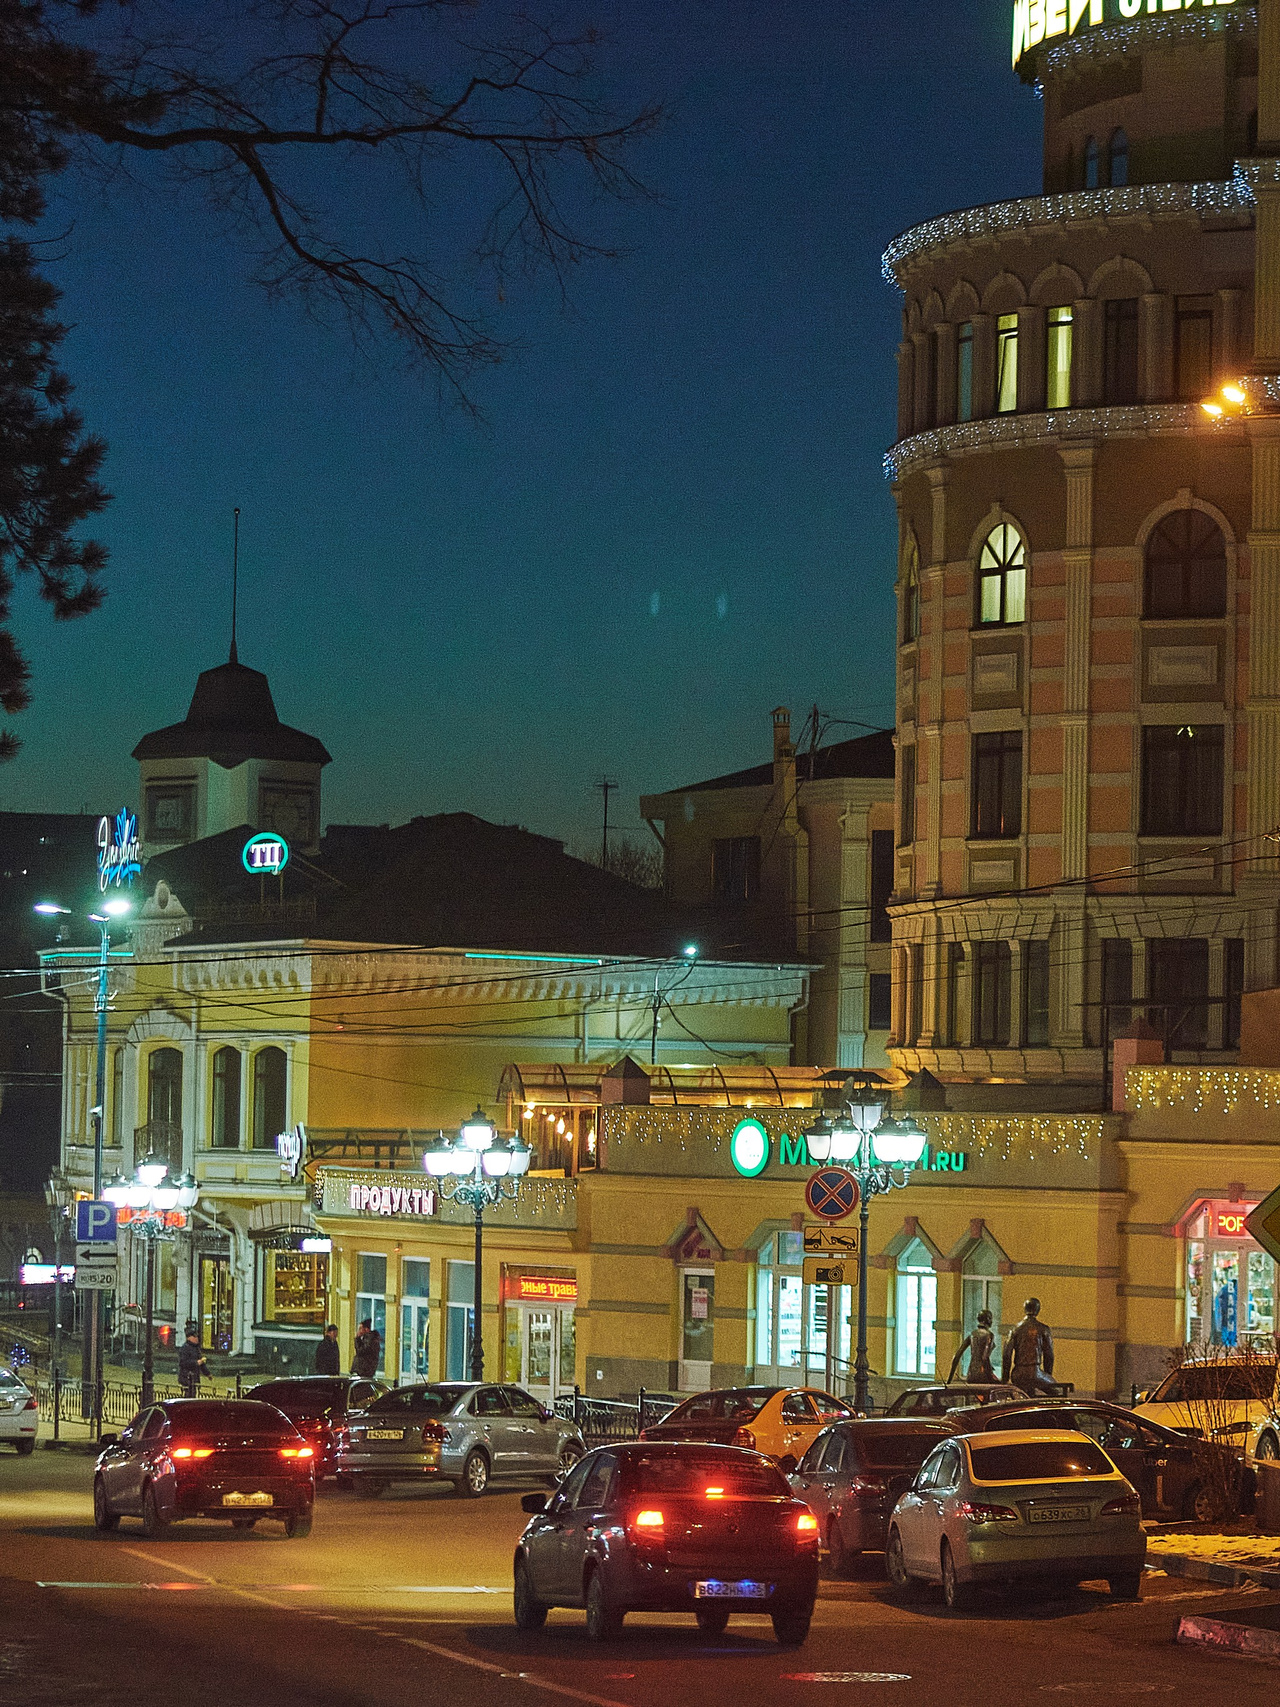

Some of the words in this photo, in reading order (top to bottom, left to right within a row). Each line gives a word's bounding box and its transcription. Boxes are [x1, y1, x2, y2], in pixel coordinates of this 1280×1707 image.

[251, 842, 282, 875] ТЦ
[350, 1184, 435, 1216] ПРОДУКТЫ
[87, 1204, 111, 1237] P
[99, 1273, 112, 1284] 20
